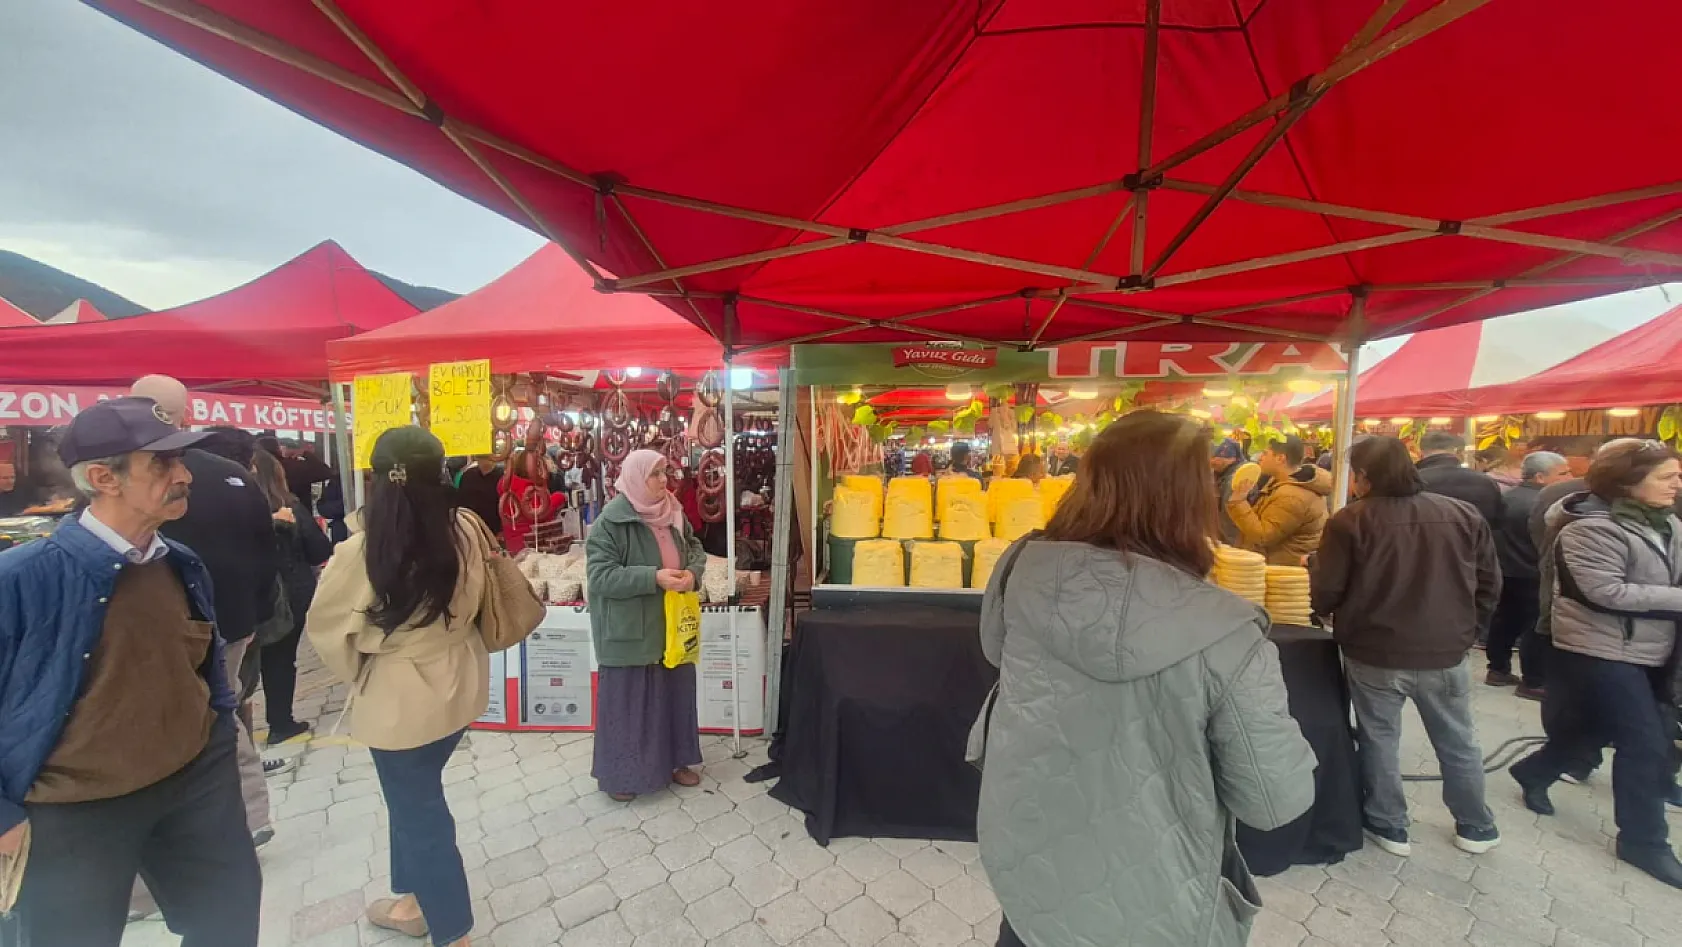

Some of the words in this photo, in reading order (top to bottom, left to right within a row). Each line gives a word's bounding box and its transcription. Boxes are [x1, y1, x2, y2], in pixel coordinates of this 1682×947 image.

[903, 349, 947, 361] Yavuz
[1048, 341, 1349, 378] TRA
[192, 398, 246, 424] BAT
